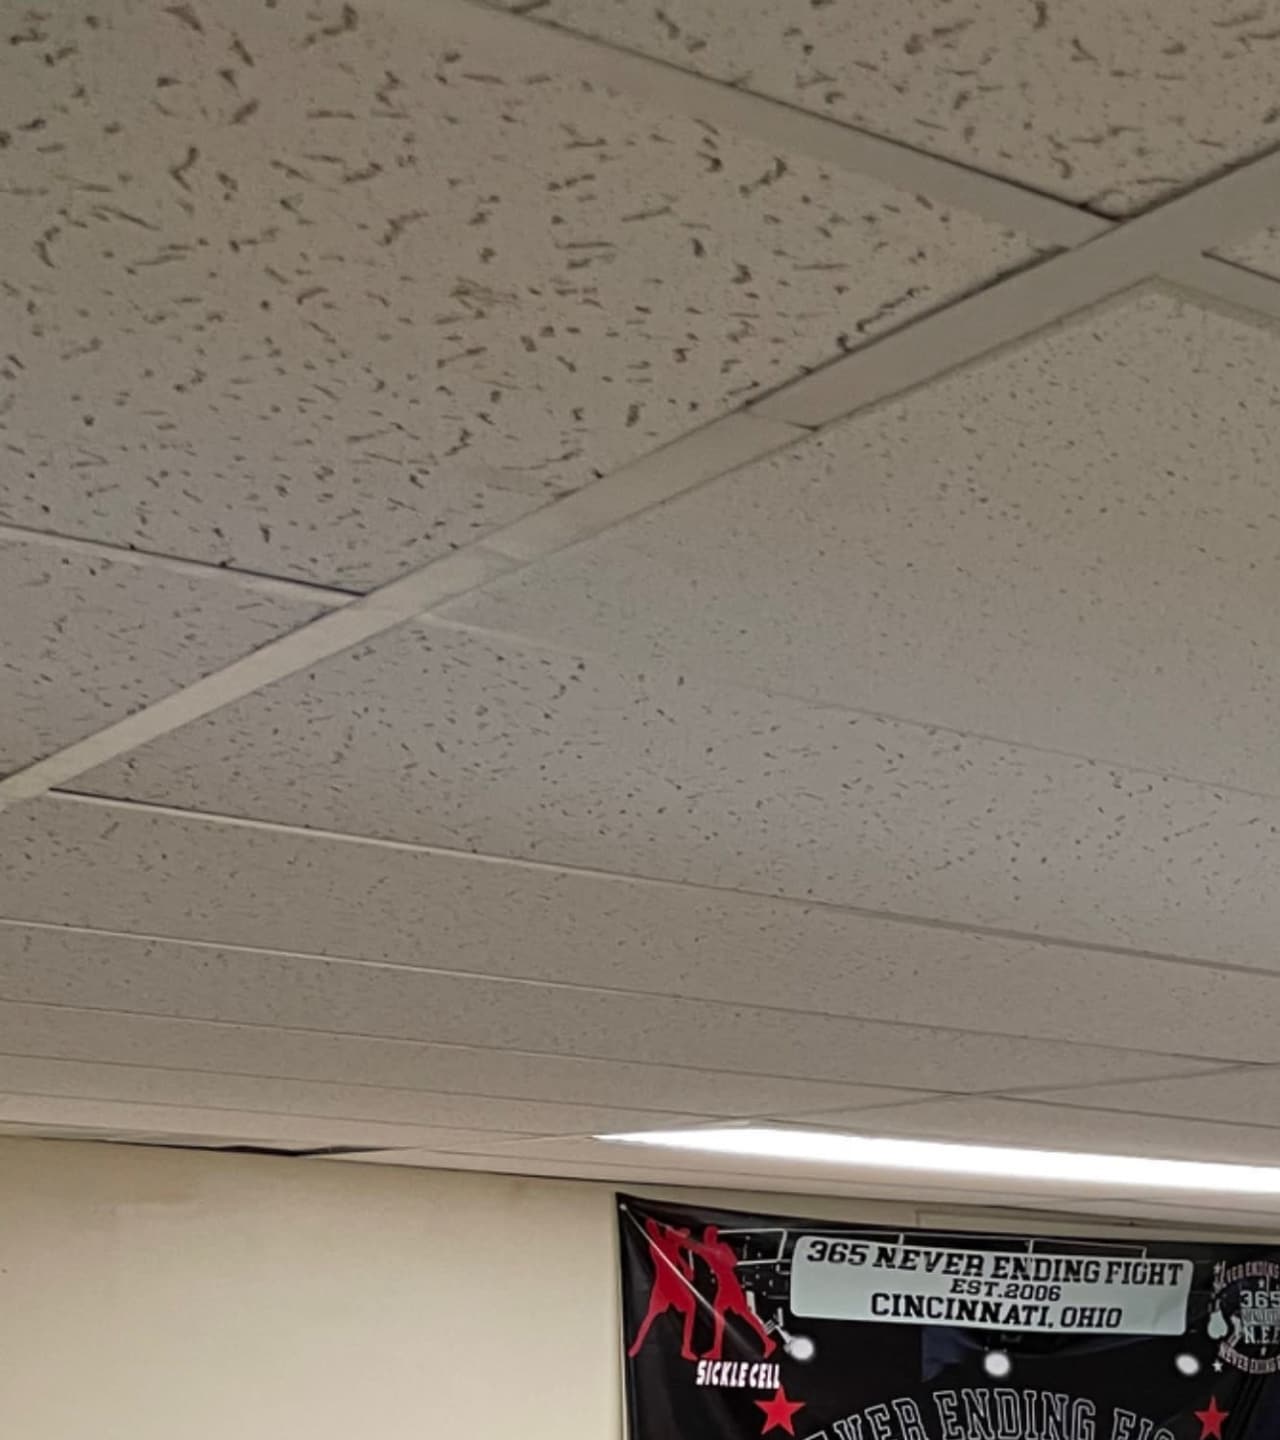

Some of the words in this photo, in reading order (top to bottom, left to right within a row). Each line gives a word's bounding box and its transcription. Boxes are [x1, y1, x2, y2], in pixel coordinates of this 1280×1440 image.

[807, 1239, 868, 1267] 365
[872, 1245, 986, 1279] NEVER
[990, 1253, 1101, 1285] ENDING
[1104, 1259, 1184, 1287] FIGHT
[949, 1278, 1062, 1302] EST.2006
[870, 1292, 1054, 1329] CINCINNATI,
[1060, 1305, 1123, 1329] OHIO
[696, 1360, 749, 1387] SICKLE
[749, 1363, 781, 1389] CELL
